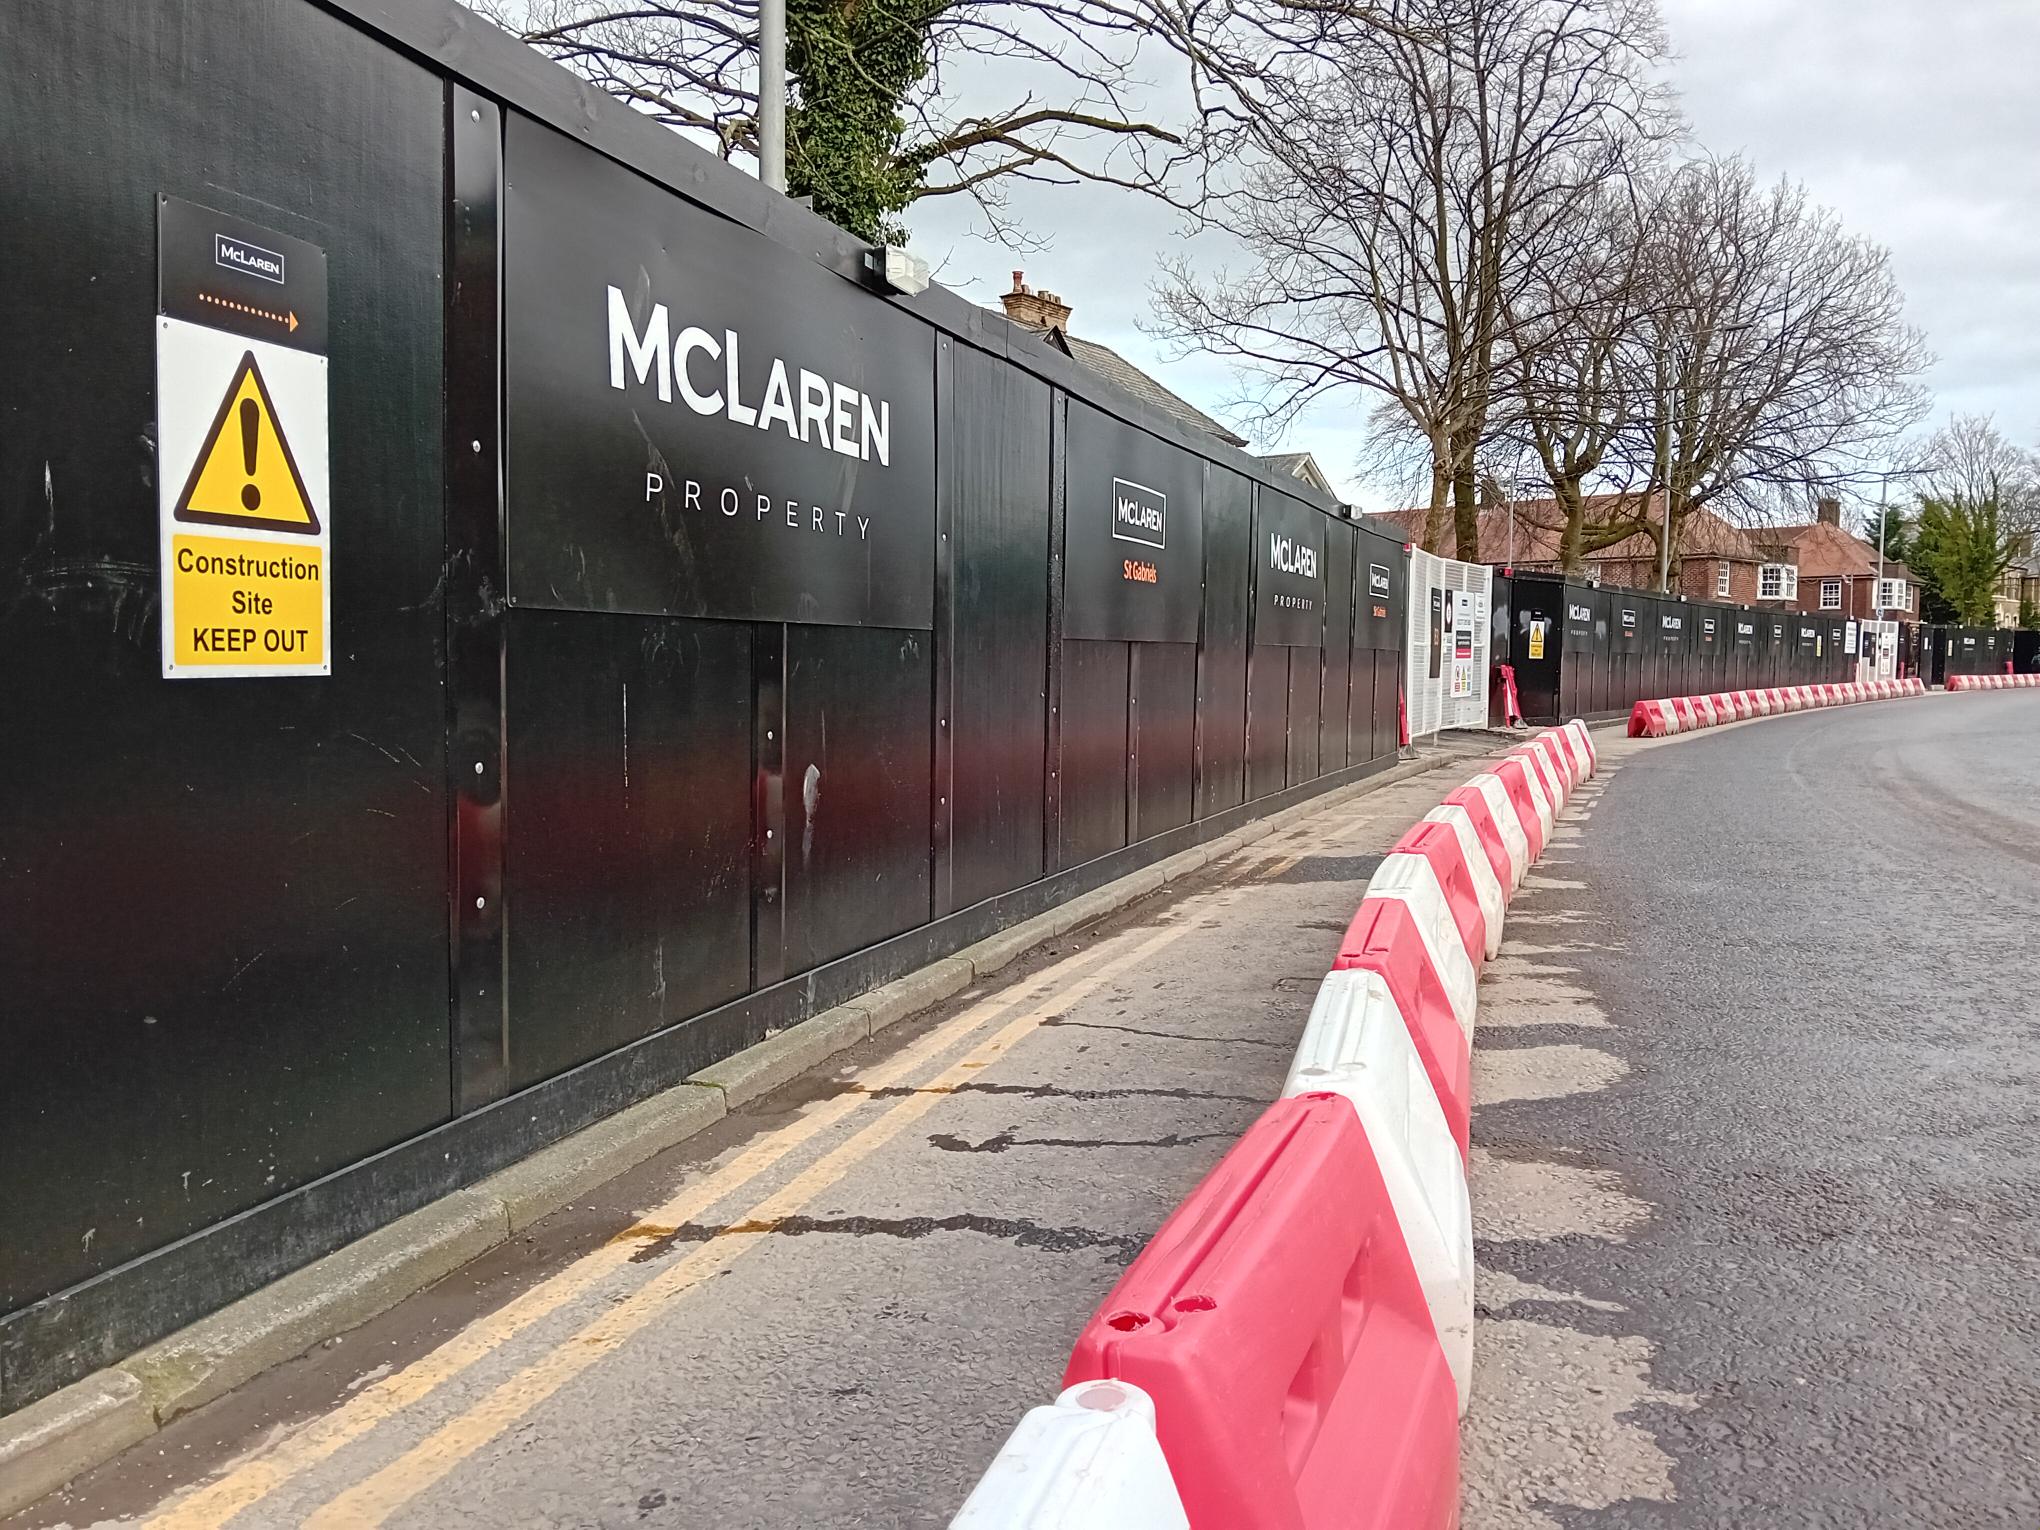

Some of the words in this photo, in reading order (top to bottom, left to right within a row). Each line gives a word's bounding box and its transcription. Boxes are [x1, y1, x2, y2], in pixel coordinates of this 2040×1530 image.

[646, 472, 870, 540] PROPERTY
[177, 547, 320, 581] Construction
[1123, 559, 1133, 581] St
[1133, 560, 1157, 584] Gabriels
[232, 590, 273, 615] Site
[1273, 594, 1313, 611] PROPERTY
[193, 628, 257, 653] KEEP
[264, 628, 309, 653] OUT
